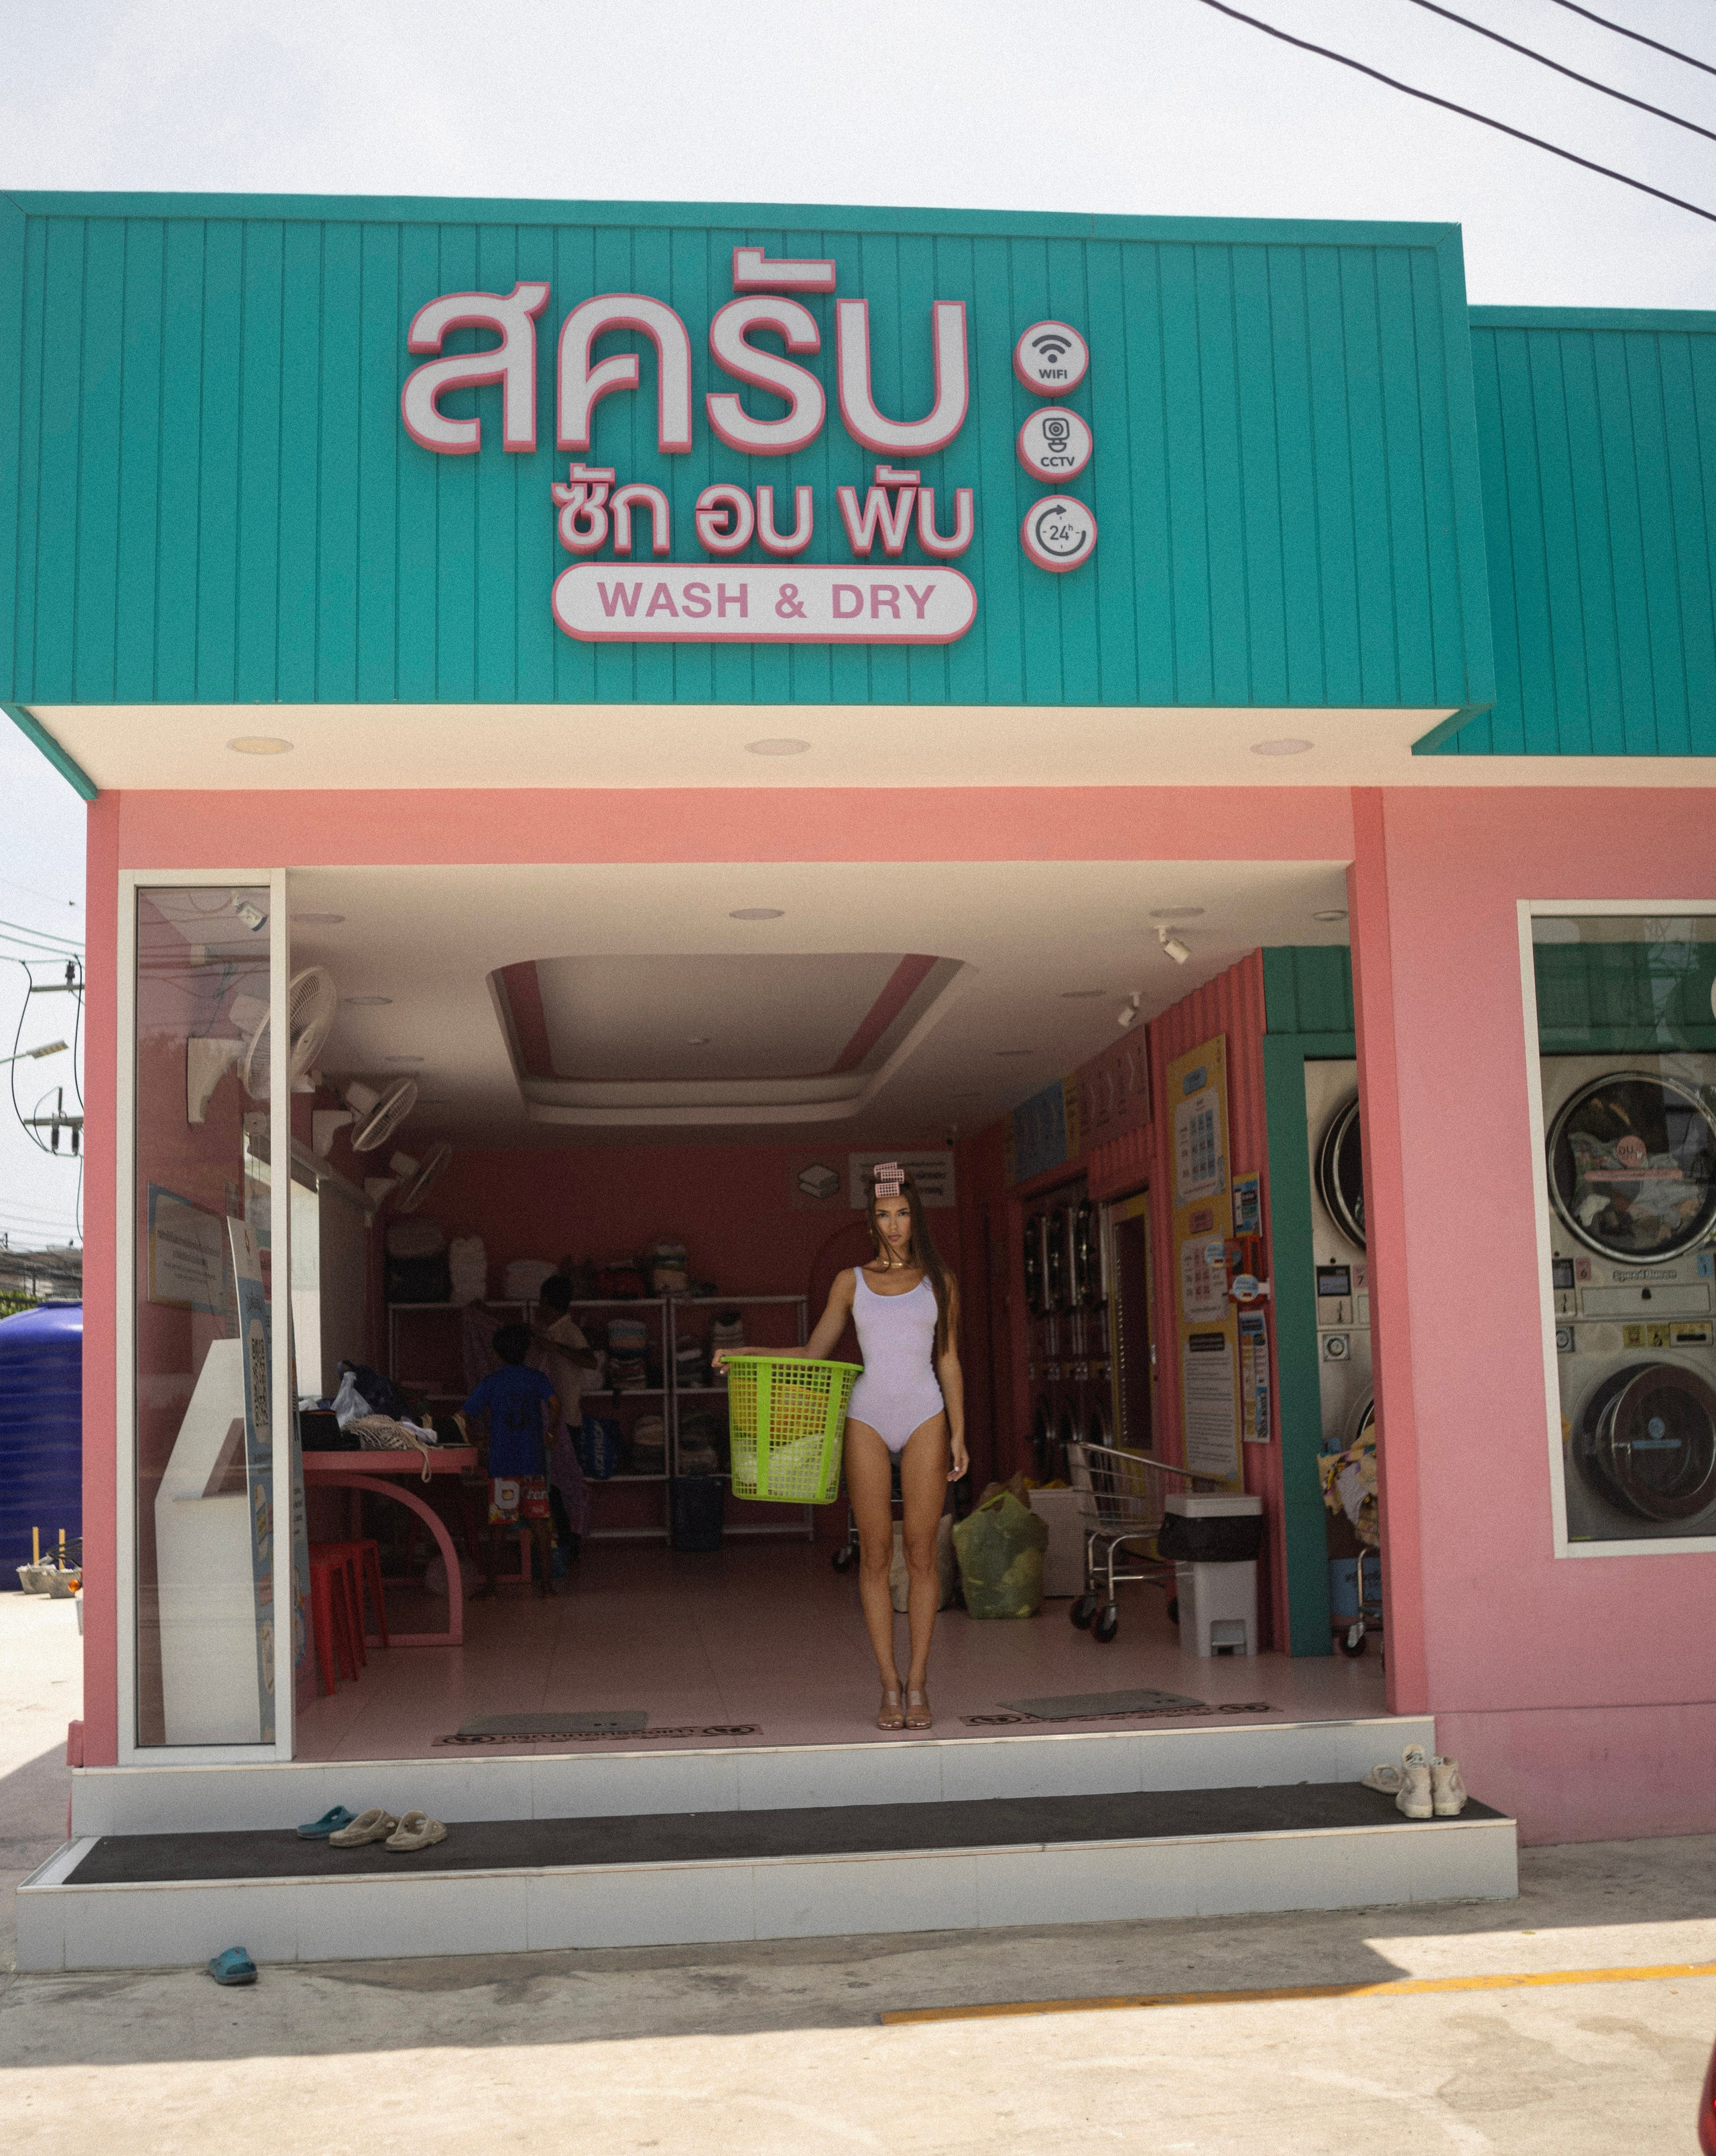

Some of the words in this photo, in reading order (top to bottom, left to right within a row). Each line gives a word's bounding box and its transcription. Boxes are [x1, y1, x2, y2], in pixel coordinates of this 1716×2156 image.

[400, 247, 969, 457] สครับ
[1039, 369, 1067, 379] WIFI
[1040, 456, 1075, 467] CCTV
[551, 463, 670, 556] ซัก
[694, 483, 813, 558] อบ
[835, 465, 975, 559] พับ
[597, 582, 749, 618] WASH
[774, 583, 807, 619] &
[832, 584, 936, 619] DRY
